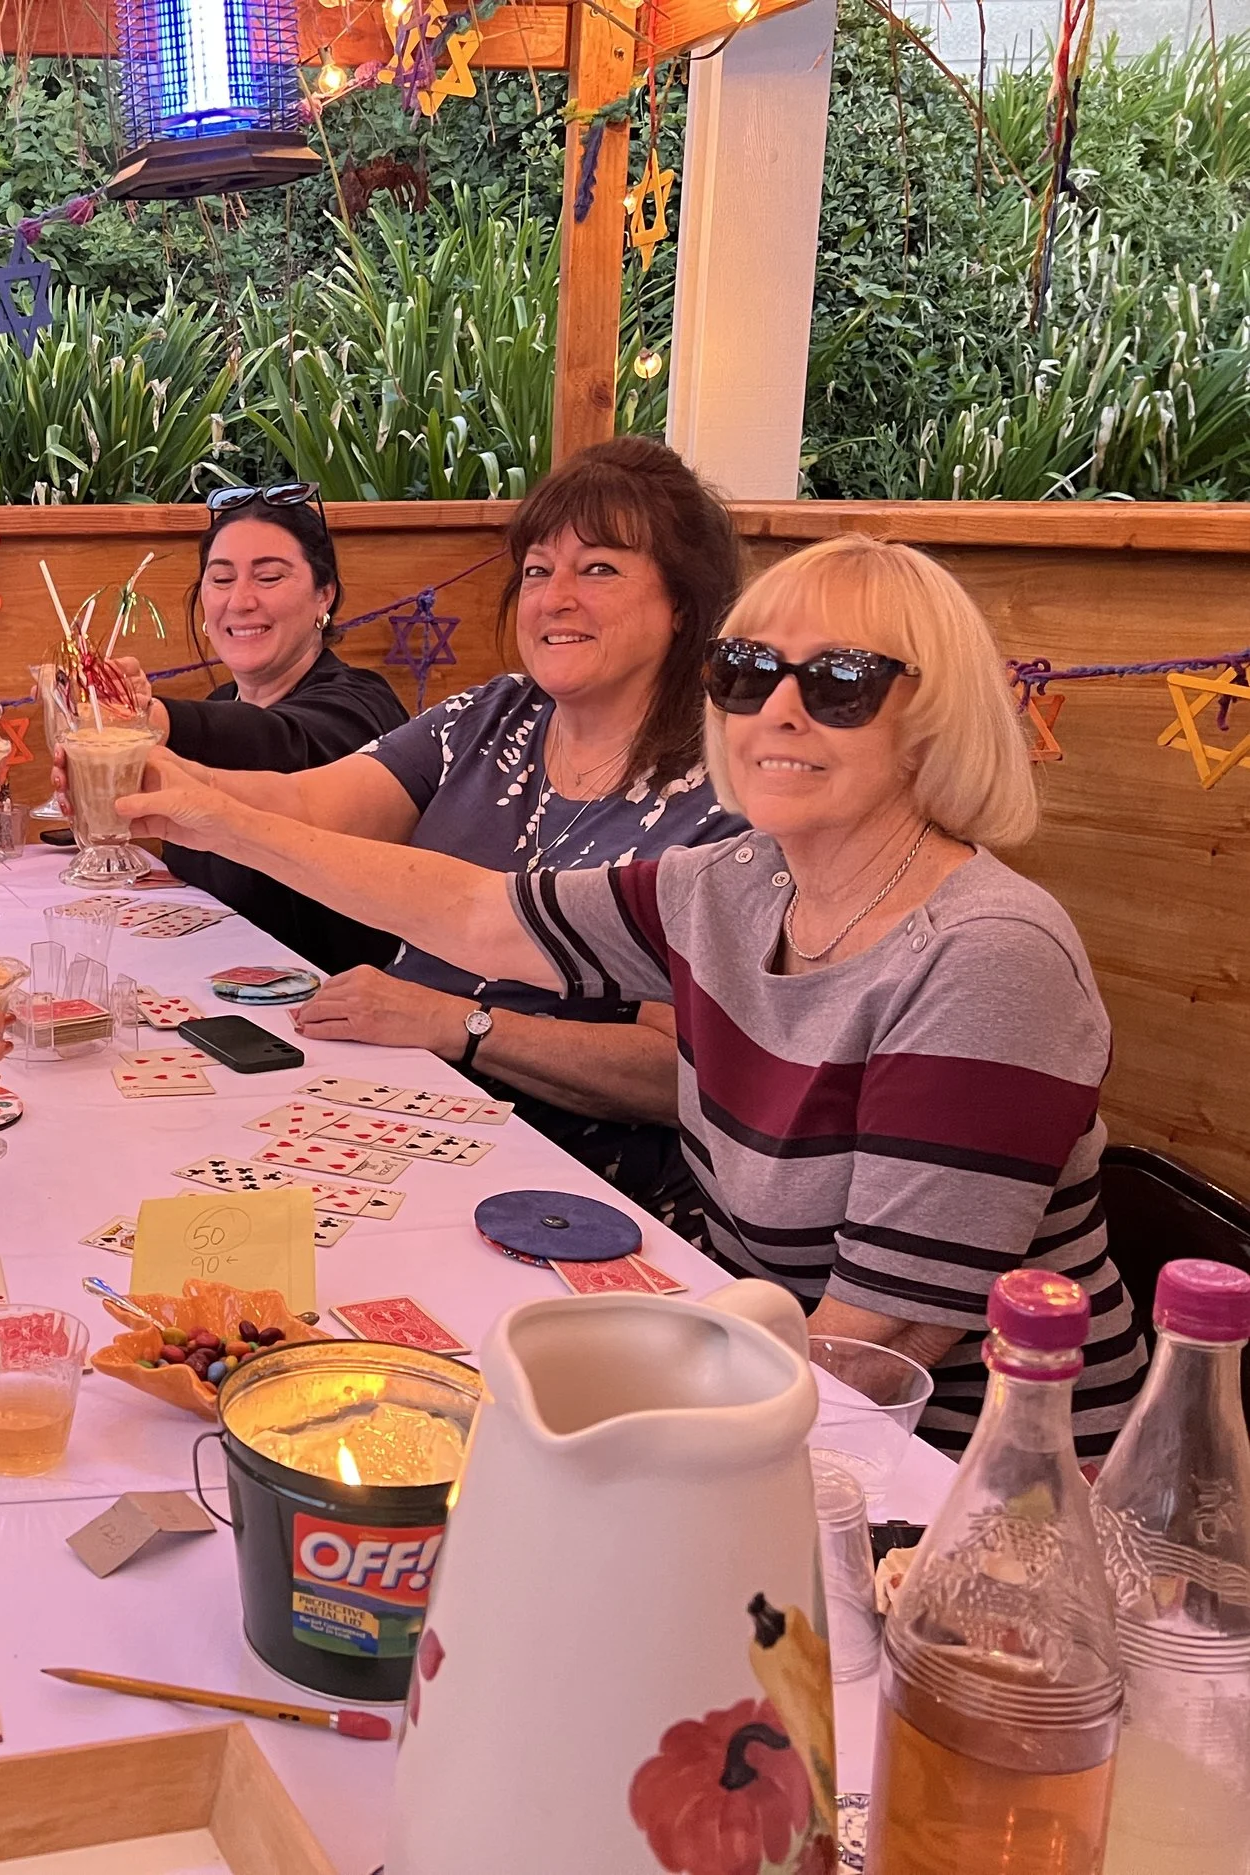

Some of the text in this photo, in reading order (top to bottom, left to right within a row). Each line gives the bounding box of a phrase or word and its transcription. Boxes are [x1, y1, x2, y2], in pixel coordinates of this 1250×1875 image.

[193, 1226, 225, 1250] 50
[191, 1255, 220, 1277] 90
[300, 1532, 443, 1590] OFF!
[299, 1595, 366, 1619] PROTECTIVE
[303, 1605, 337, 1621] METAL
[343, 1615, 362, 1628] LID
